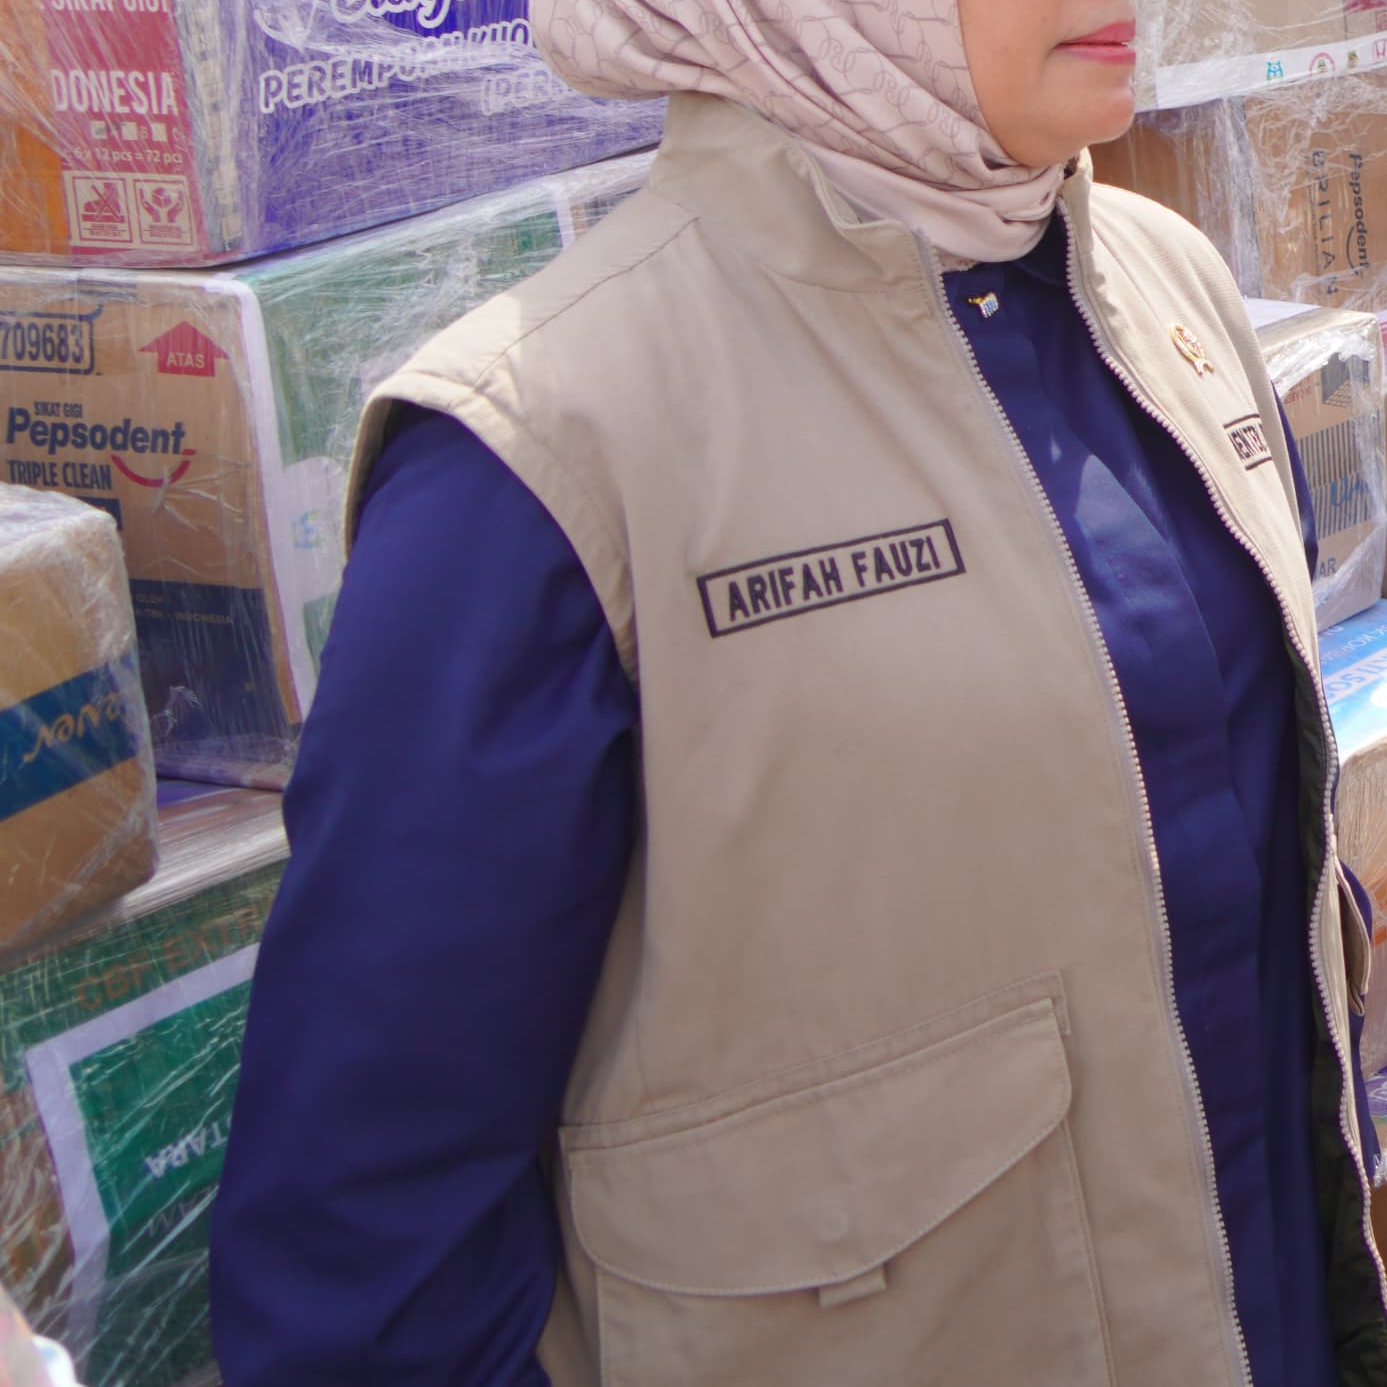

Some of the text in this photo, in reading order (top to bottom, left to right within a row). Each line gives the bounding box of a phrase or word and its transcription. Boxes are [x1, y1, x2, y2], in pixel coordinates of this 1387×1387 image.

[1349, 152, 1371, 270] Pepsodent
[165, 352, 206, 369] ATAS
[33, 401, 62, 417] SIKAT
[6, 407, 186, 455] Pepsodent
[9, 460, 113, 490] TRIPLE CLEAN
[728, 535, 942, 622] ARIFAH FAUZI
